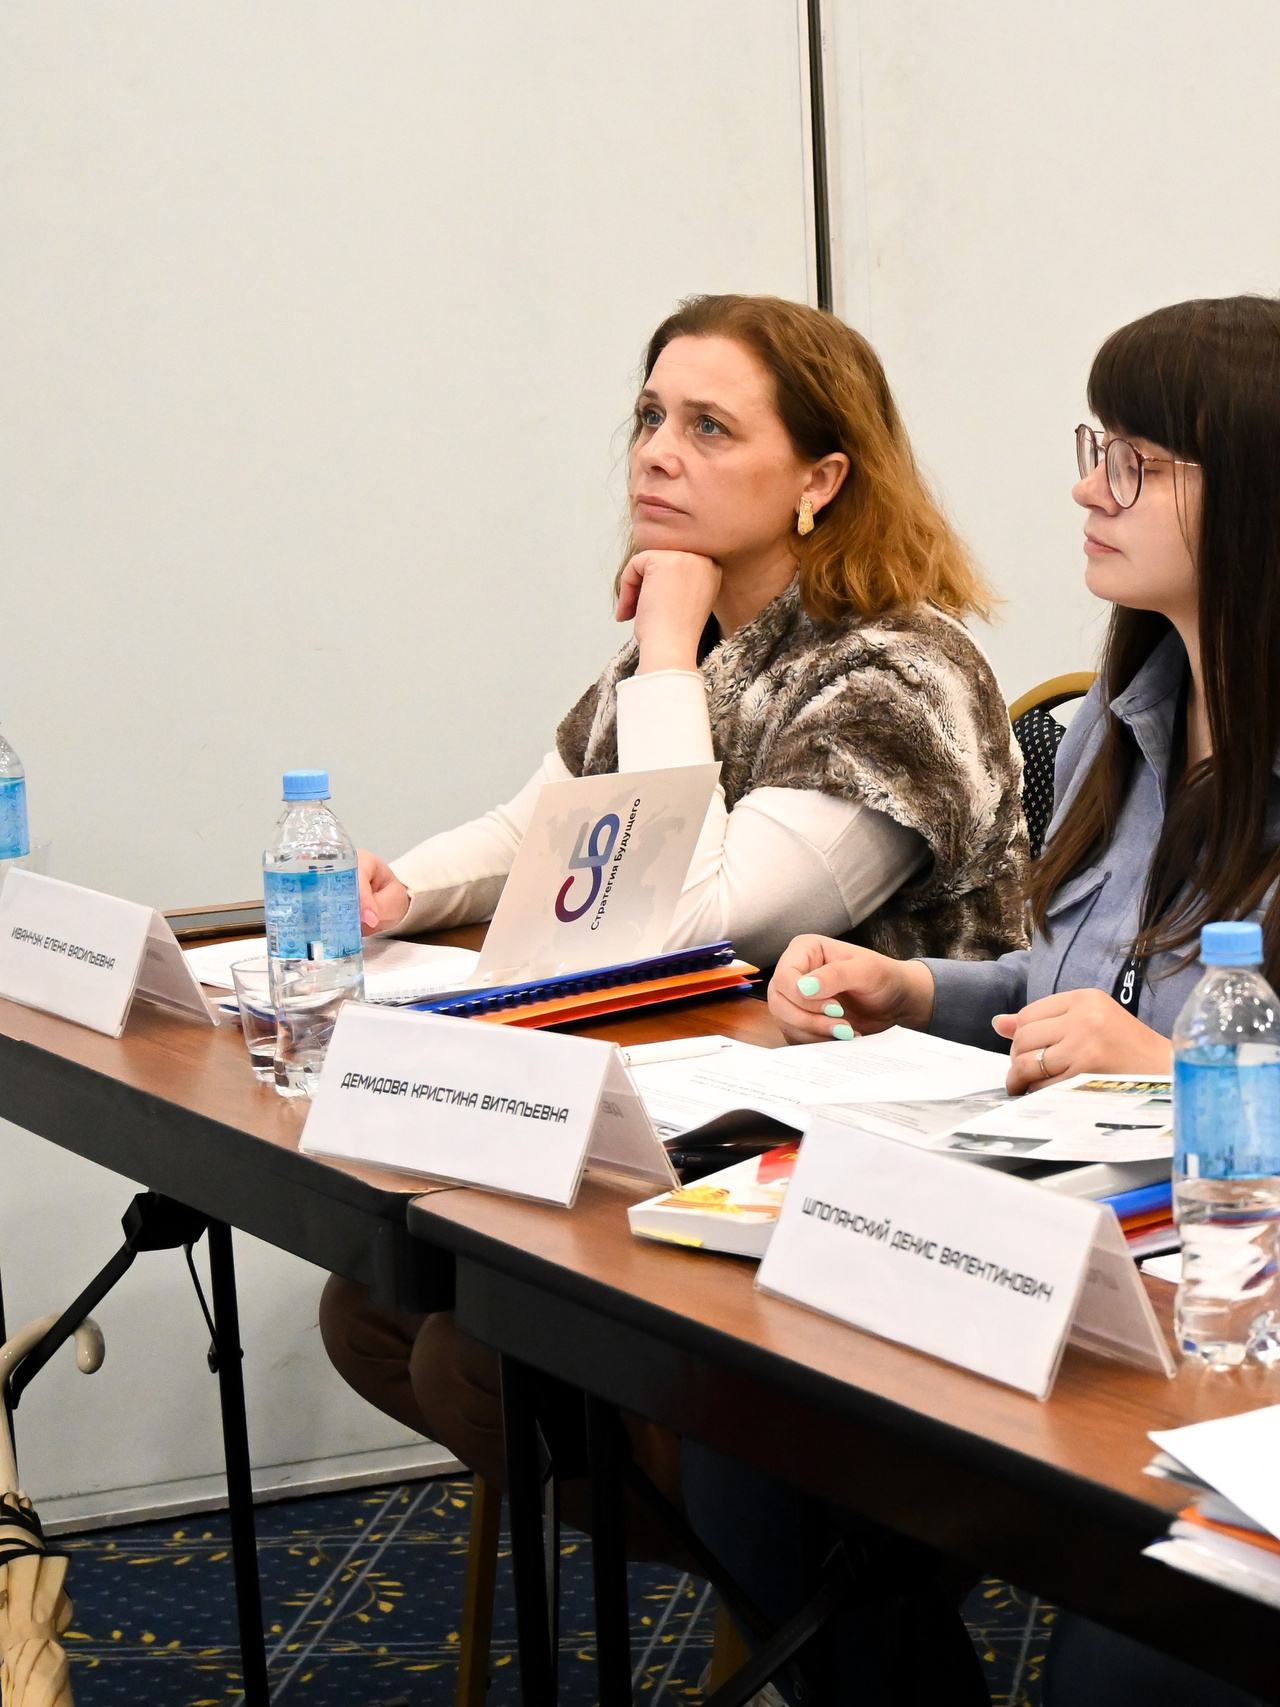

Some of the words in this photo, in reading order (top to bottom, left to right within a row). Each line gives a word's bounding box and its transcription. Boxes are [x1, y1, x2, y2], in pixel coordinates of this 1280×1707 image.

[590, 865, 619, 930] Стратегия
[614, 798, 641, 862] Будущего
[11, 926, 44, 947] ИВАНЧУК
[43, 936, 68, 955] ЕЛЕНА
[67, 944, 116, 970] ВАСИЛЬЕВНА
[340, 1072, 409, 1096] ДЕМИДОВА
[411, 1083, 479, 1108] КРИСТИНА
[480, 1094, 569, 1124] ВИТАЛЬЕВНА
[802, 1196, 892, 1243] ШПОЛЯНСКИЙ
[889, 1229, 938, 1260] ДЕНИС
[939, 1247, 1054, 1302] ВАЛЕНТИНОВИЧ
